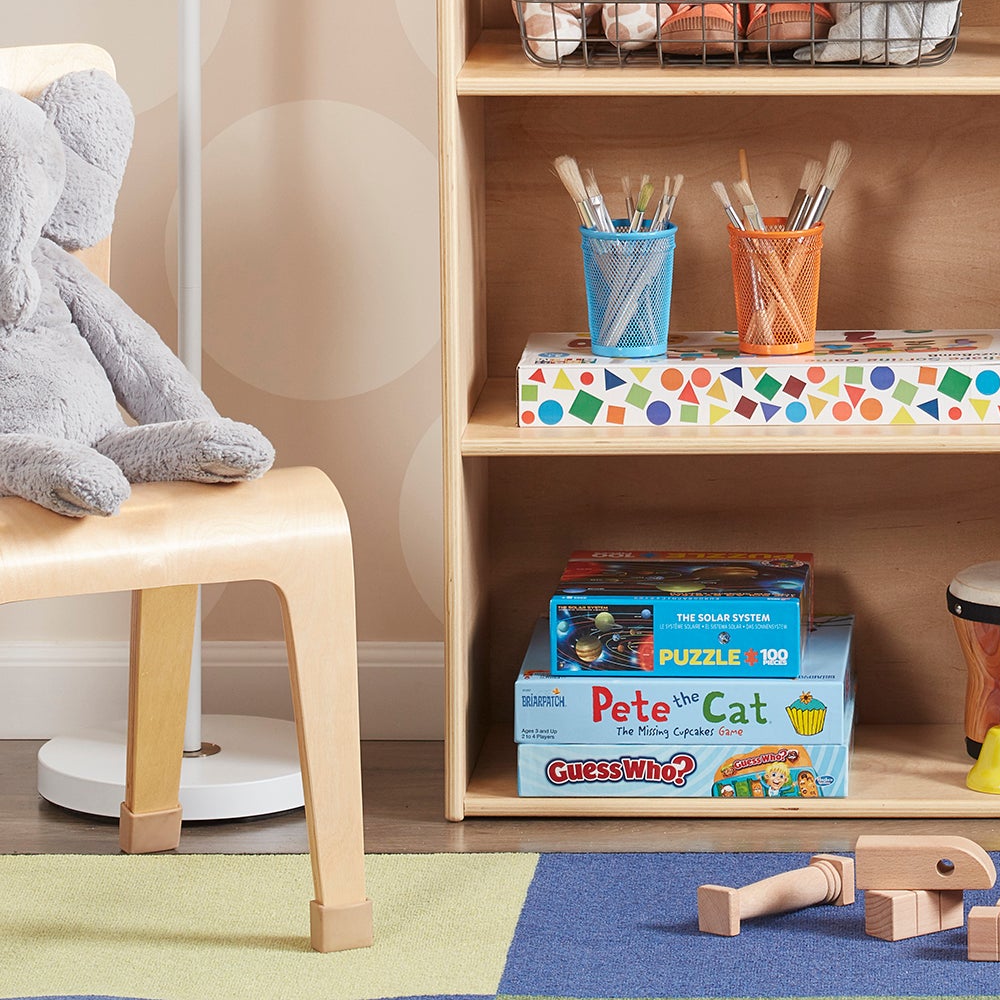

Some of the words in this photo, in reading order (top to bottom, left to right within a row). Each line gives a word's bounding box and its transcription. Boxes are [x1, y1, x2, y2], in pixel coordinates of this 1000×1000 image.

[677, 613, 696, 622] THE
[698, 613, 730, 622] SOLAR
[732, 613, 771, 622] SYSTEM
[659, 649, 741, 666] PUZZLE
[760, 648, 789, 661] 100
[521, 692, 566, 708] BRIARPATCH
[592, 685, 671, 723] Pete
[673, 691, 700, 708] the
[702, 691, 767, 724] Cat
[617, 726, 634, 736] The
[638, 725, 669, 739] Missing
[673, 727, 714, 739] Cupcakes
[718, 726, 743, 736] Game
[733, 755, 761, 770] Guess
[761, 749, 788, 763] Who?
[547, 759, 622, 783] Guess
[622, 753, 696, 787] Who?
